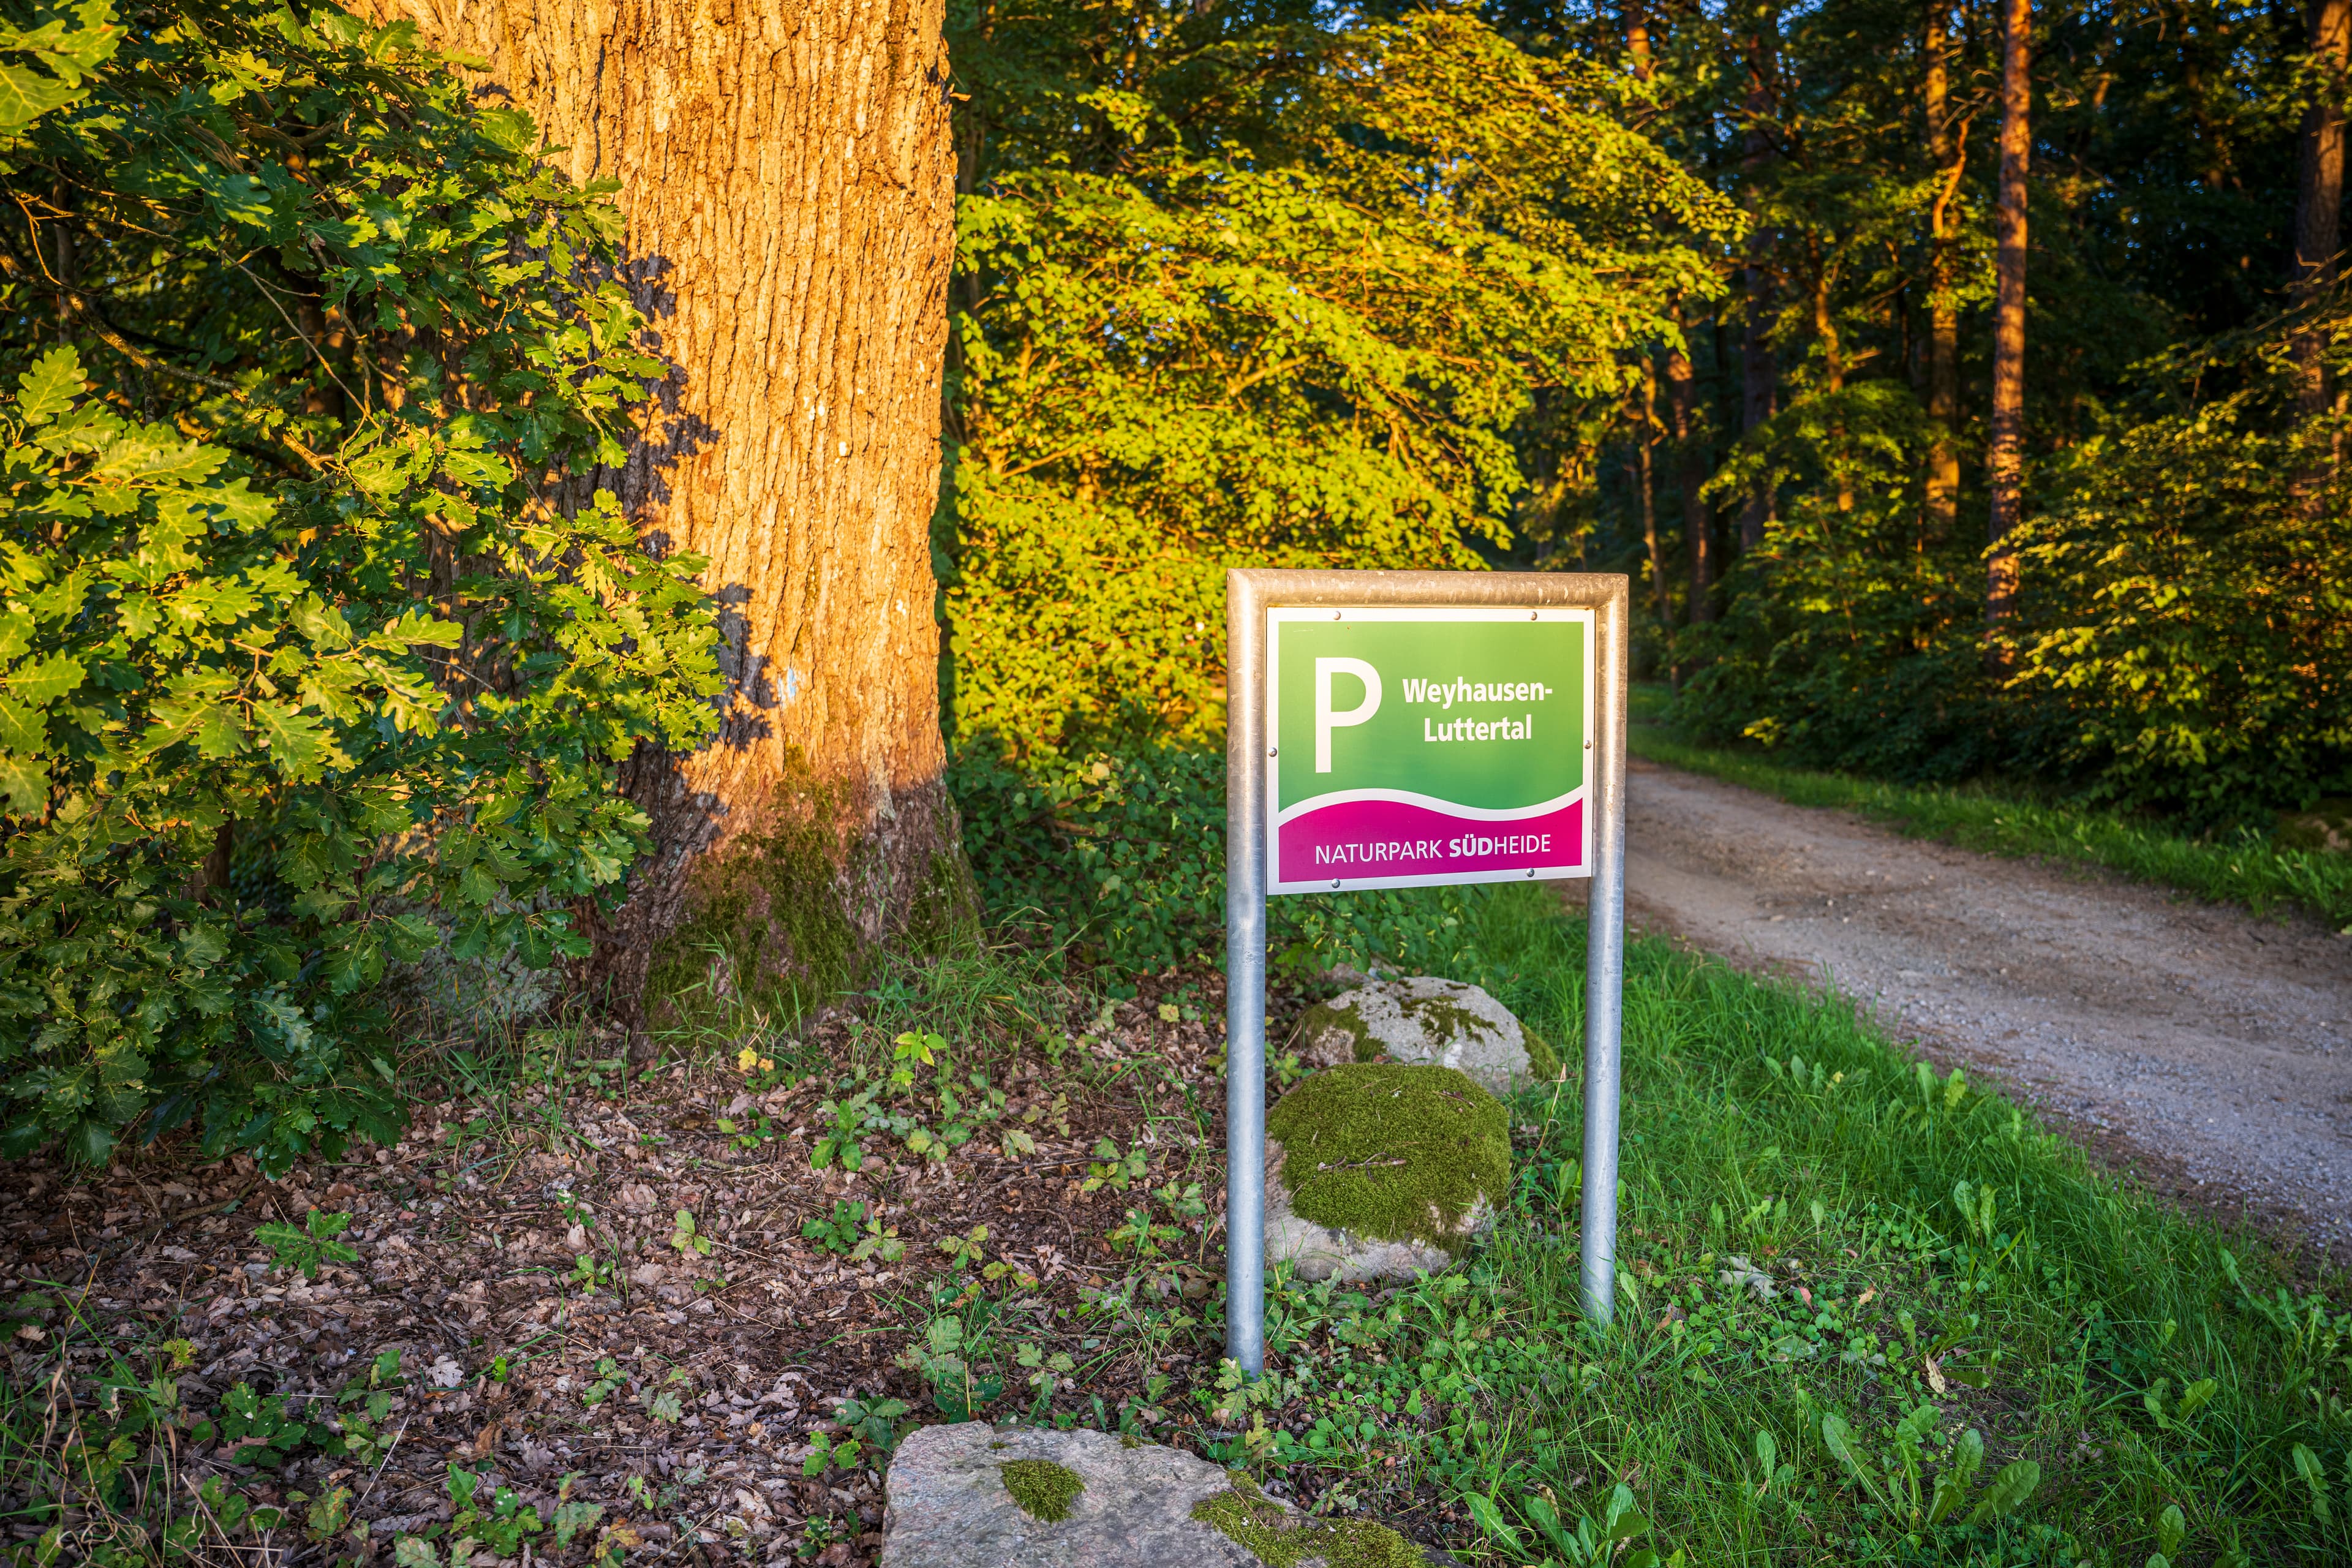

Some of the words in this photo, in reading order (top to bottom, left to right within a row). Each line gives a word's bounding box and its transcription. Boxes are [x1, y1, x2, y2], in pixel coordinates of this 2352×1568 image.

[1402, 676, 1553, 709] Weyhausen-
[1315, 657, 1382, 774] P
[1424, 714, 1532, 742] Luttertal
[1316, 839, 1443, 864] NATURPARK
[1449, 834, 1551, 858] SÜDHEIDE
